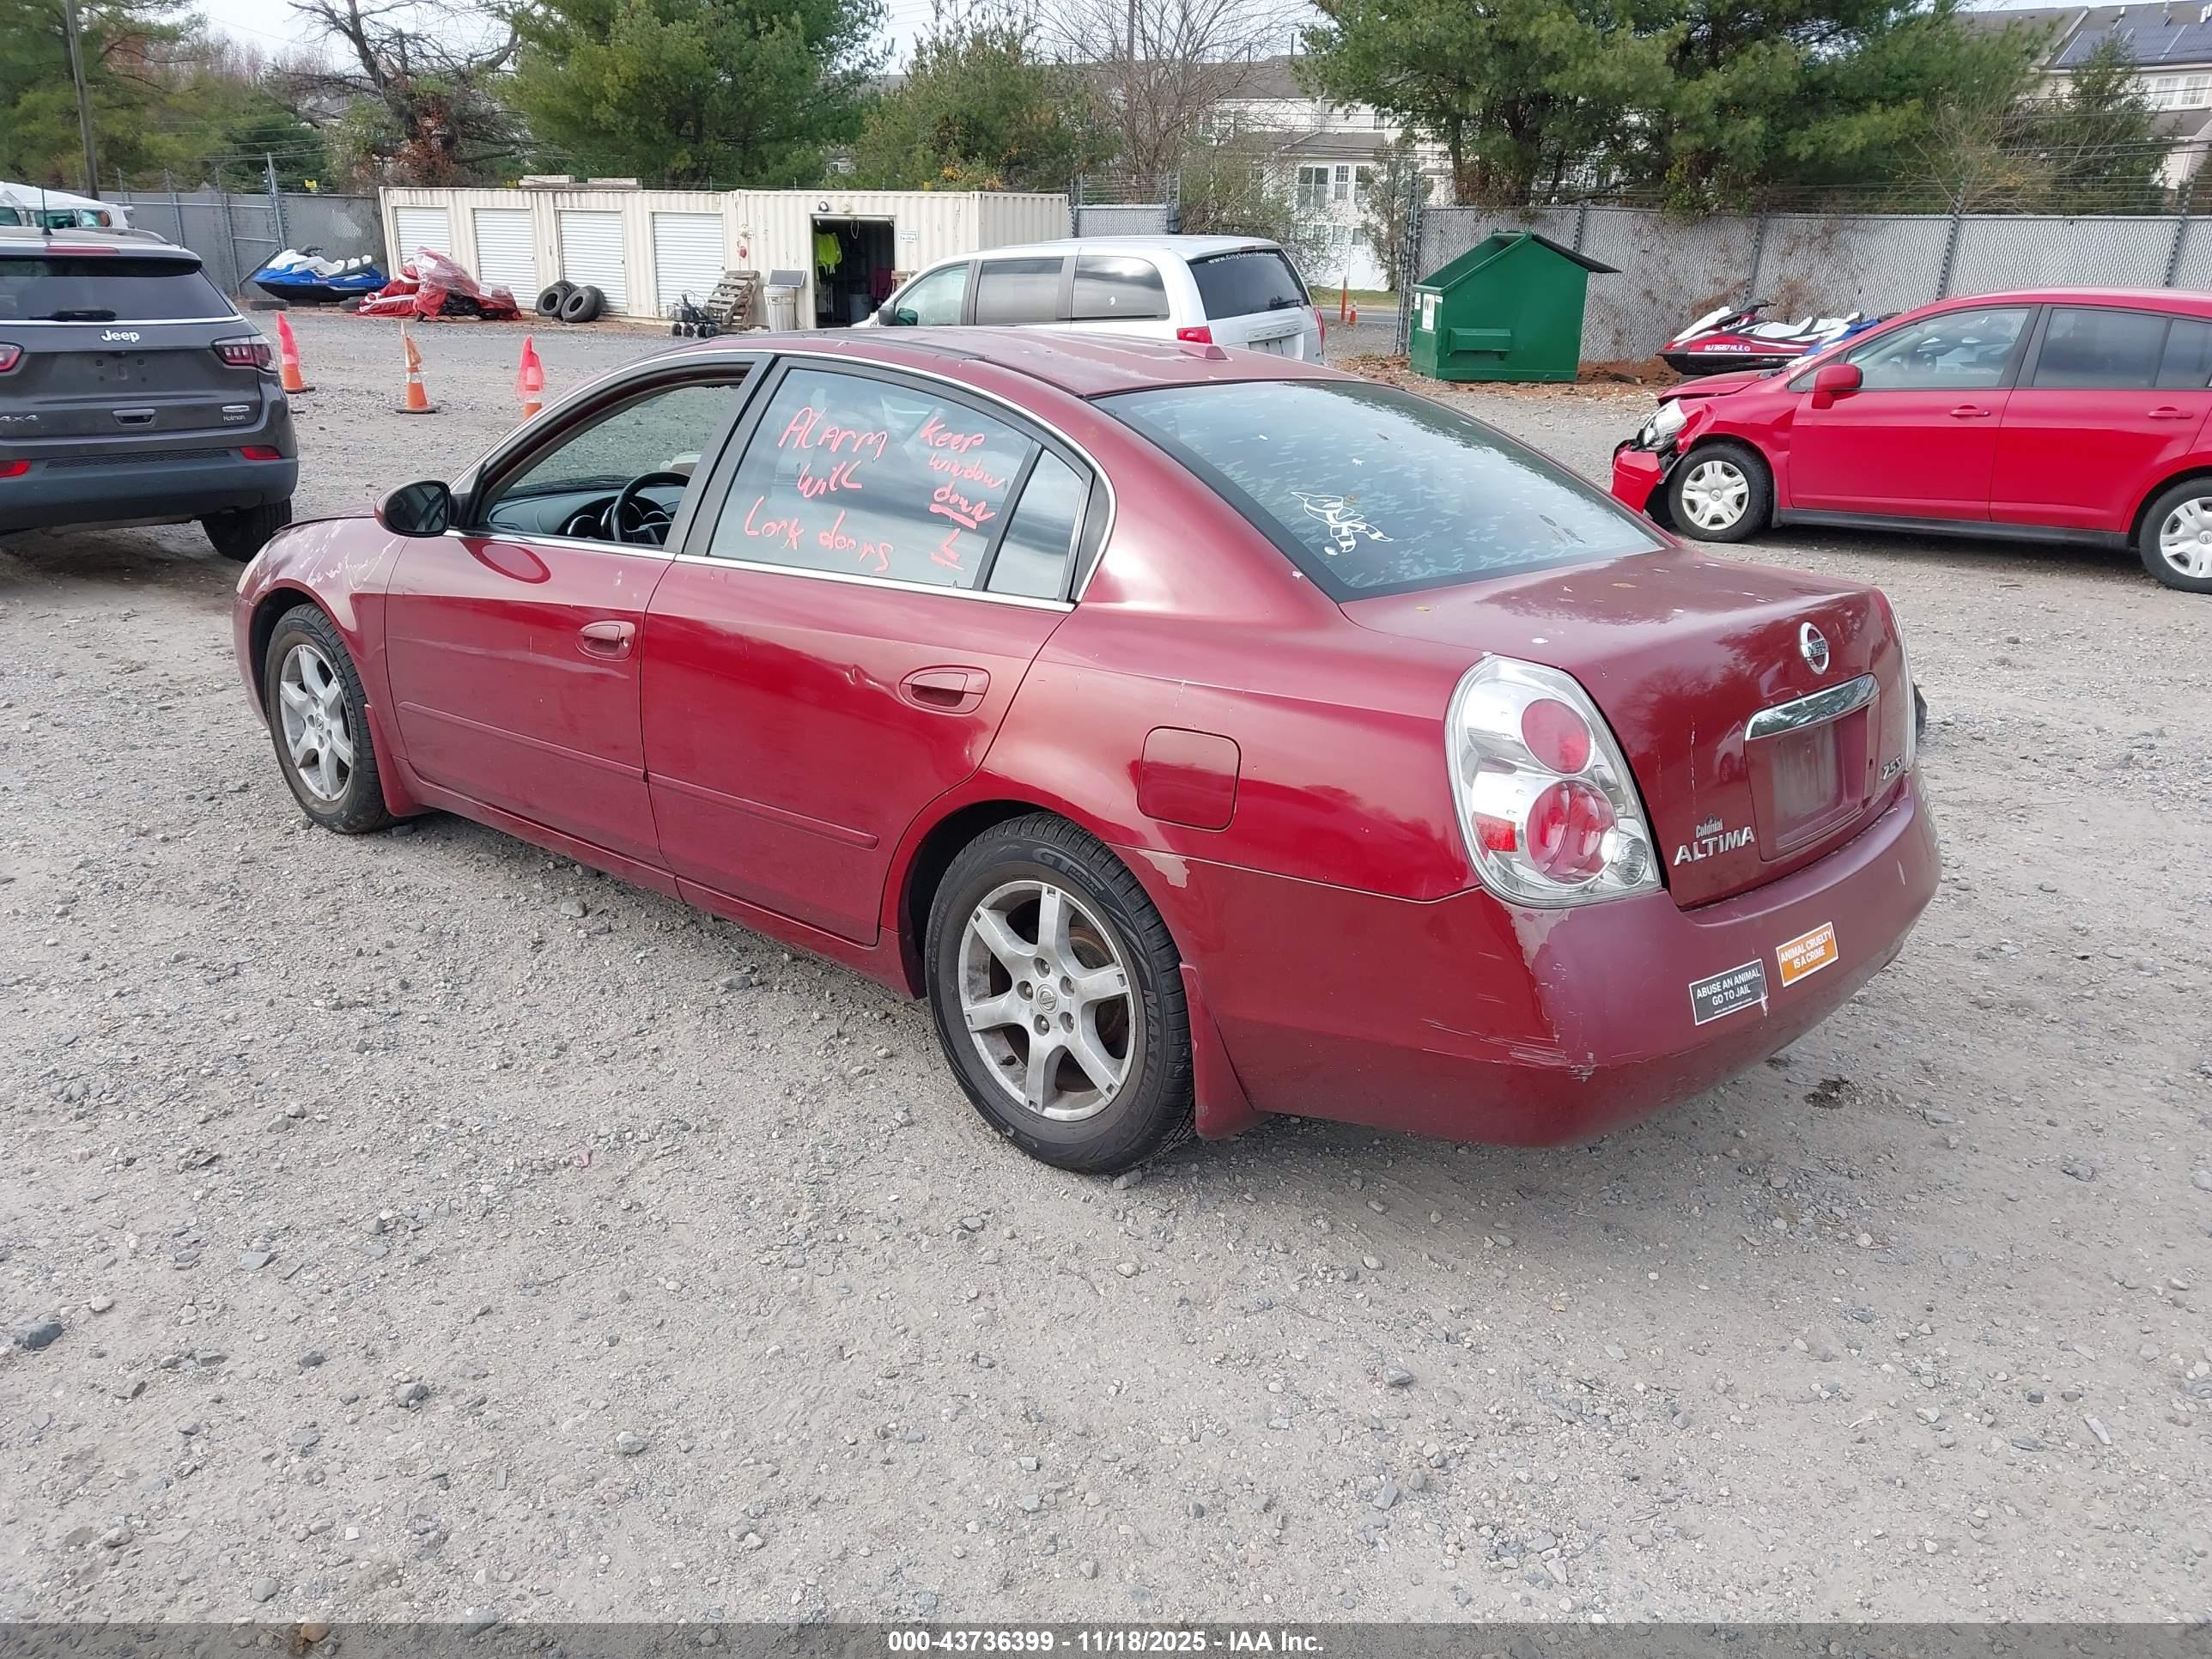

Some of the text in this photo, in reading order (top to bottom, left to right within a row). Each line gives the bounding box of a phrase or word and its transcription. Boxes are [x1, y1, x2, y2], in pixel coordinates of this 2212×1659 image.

[100, 329, 140, 343] Jeep
[1696, 818, 1723, 838] Colonial
[1673, 826, 1755, 866] ALTIMA
[1780, 928, 1832, 964] ANIMAL CRUELTY
[1793, 957, 1801, 969] IS
[1806, 945, 1826, 962] CRIME
[1697, 968, 1761, 1000] ABUSE AN ANIMAL
[1711, 994, 1724, 1006] GO
[1723, 989, 1735, 1001] TO
[1735, 983, 1752, 998] JAIL
